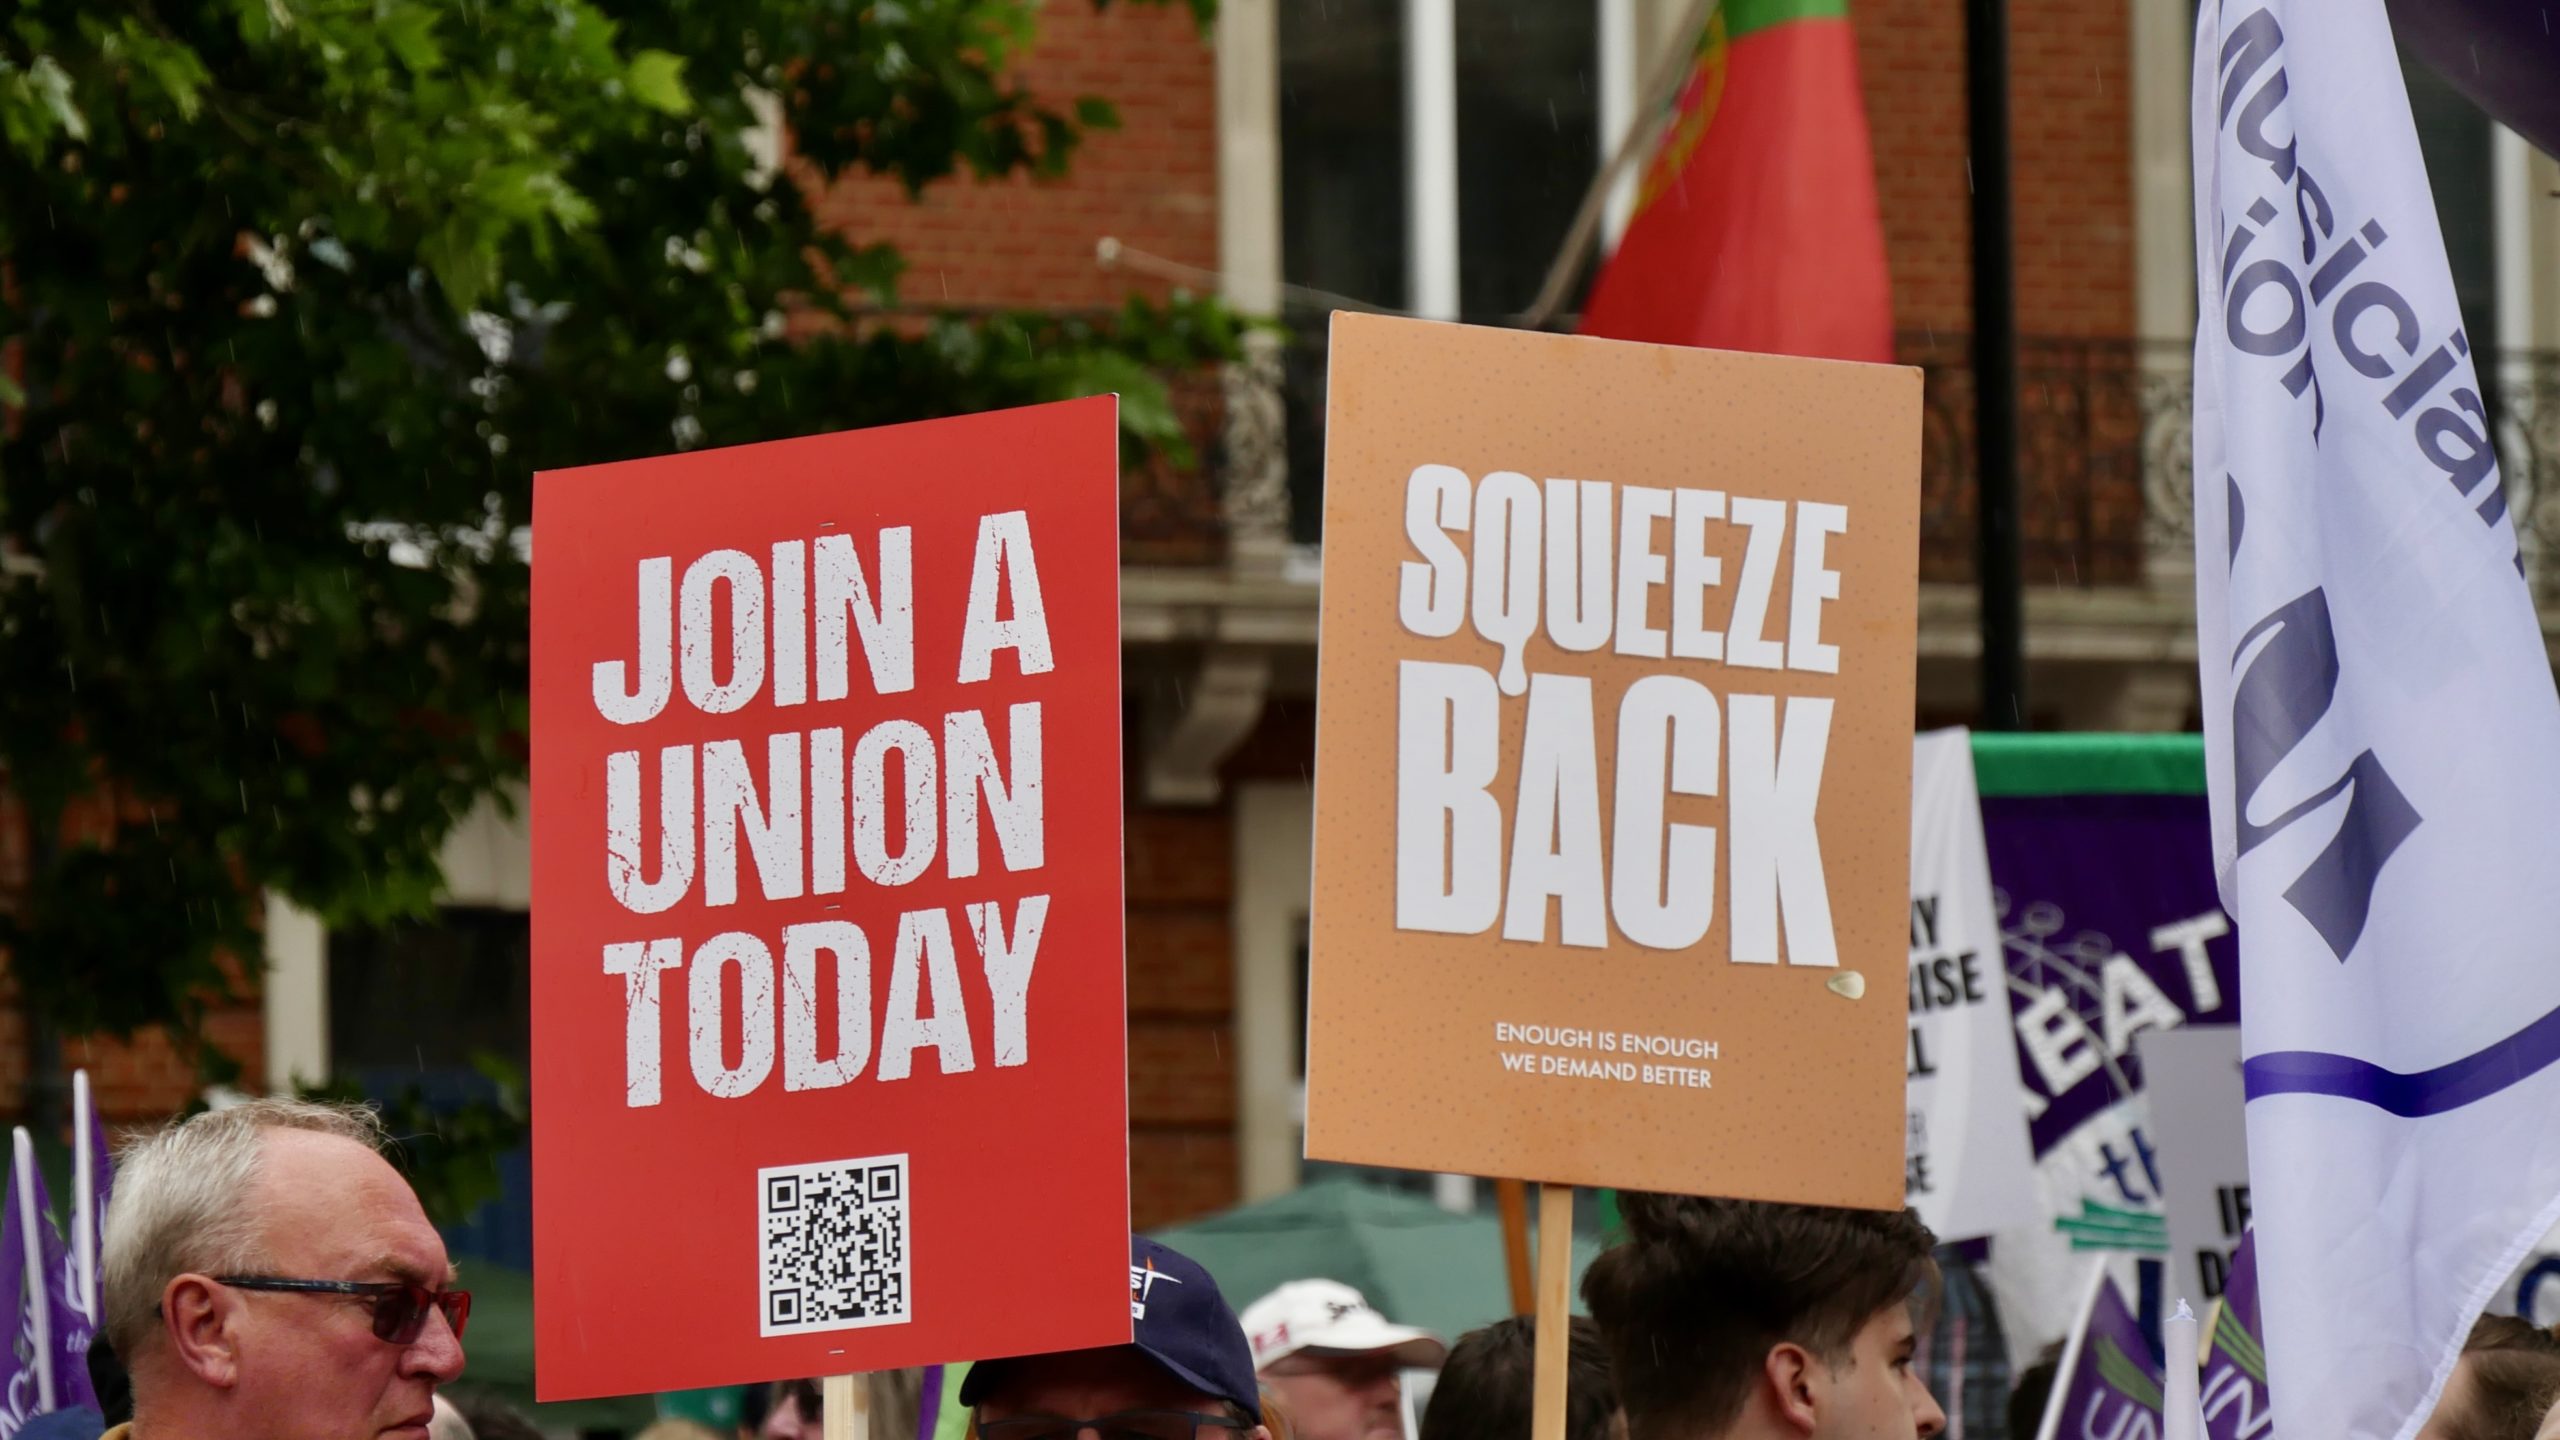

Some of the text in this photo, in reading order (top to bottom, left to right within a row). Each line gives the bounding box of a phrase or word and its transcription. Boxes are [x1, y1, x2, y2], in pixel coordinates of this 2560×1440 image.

[592, 510, 1055, 726] JOIN A
[1398, 463, 1849, 697] SQUEEZE
[606, 701, 1045, 915] UNION
[1396, 659, 1840, 967] BACK
[603, 894, 1051, 1108] TODAY
[1495, 1021, 1719, 1060] ENOUGH IS ENOUGH
[1500, 1051, 1713, 1089] WE DEMAND BETTER
